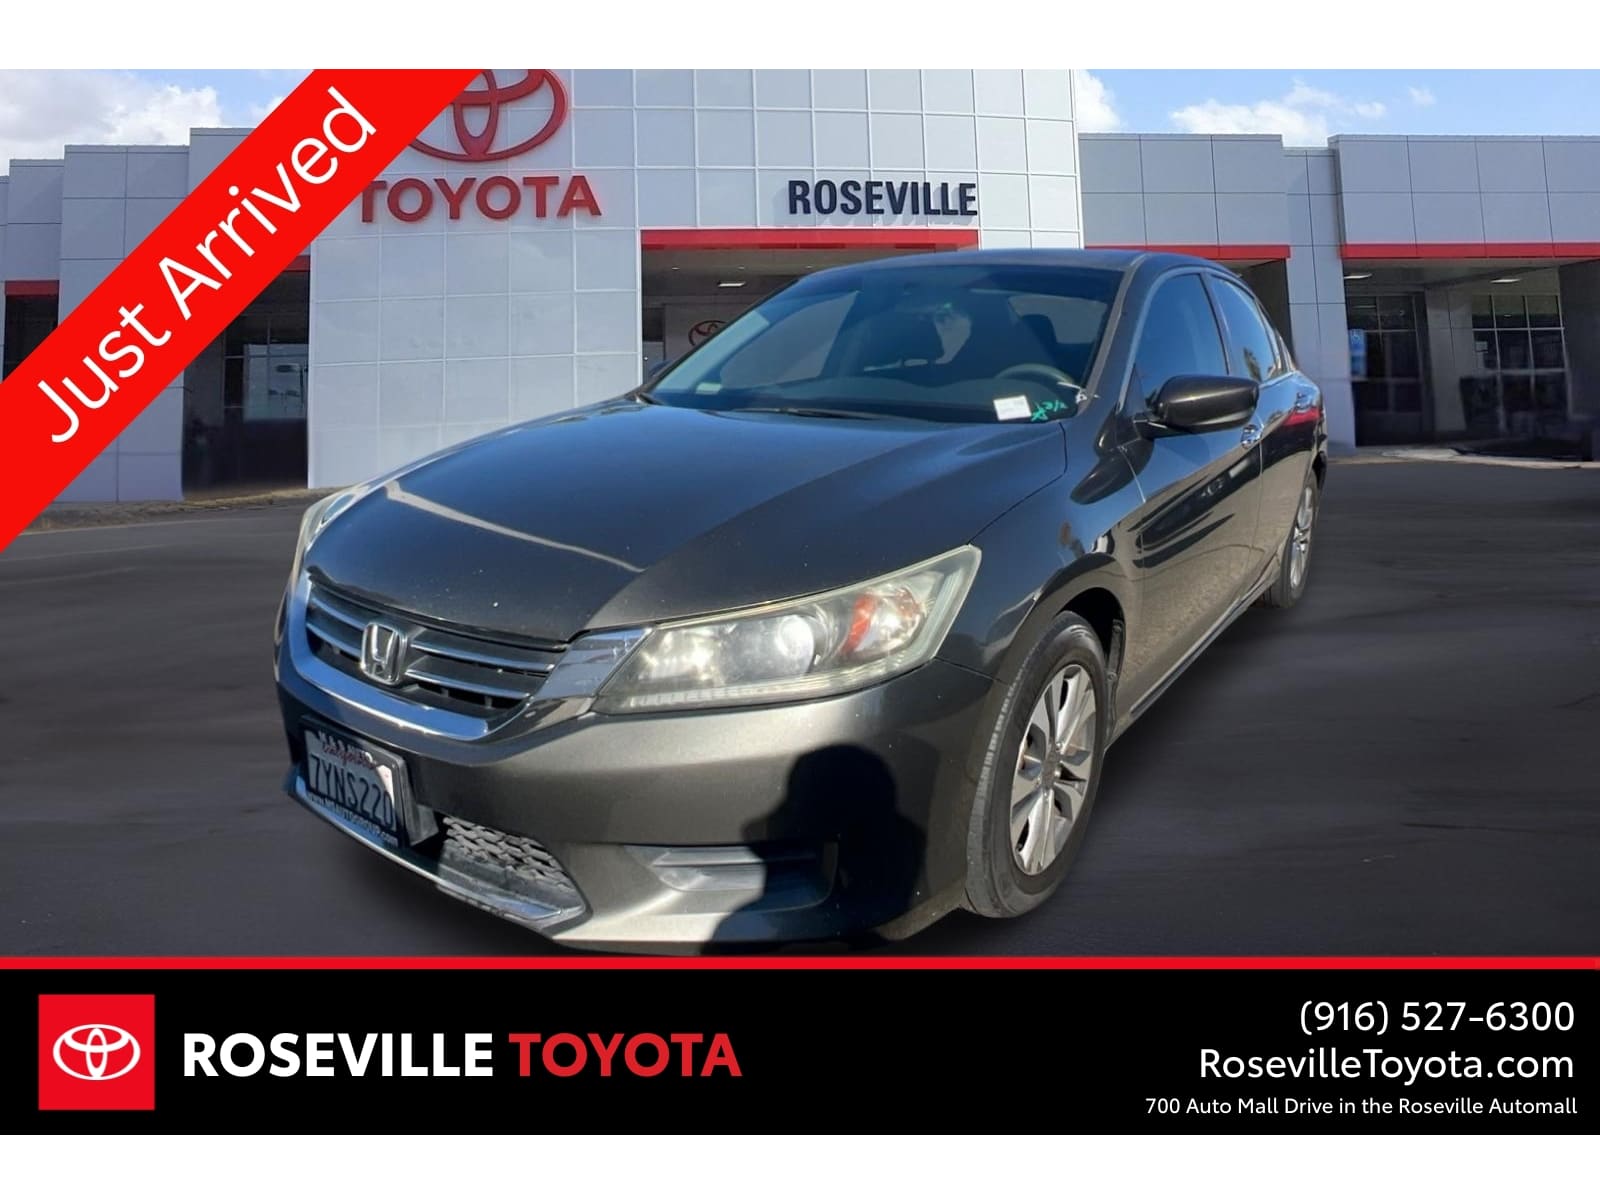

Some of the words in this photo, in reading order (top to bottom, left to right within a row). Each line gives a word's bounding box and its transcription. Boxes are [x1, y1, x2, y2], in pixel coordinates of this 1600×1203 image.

[360, 175, 602, 223] TOYOTA
[788, 179, 978, 216] ROSEVILLE
[309, 752, 395, 830] 7YNS220
